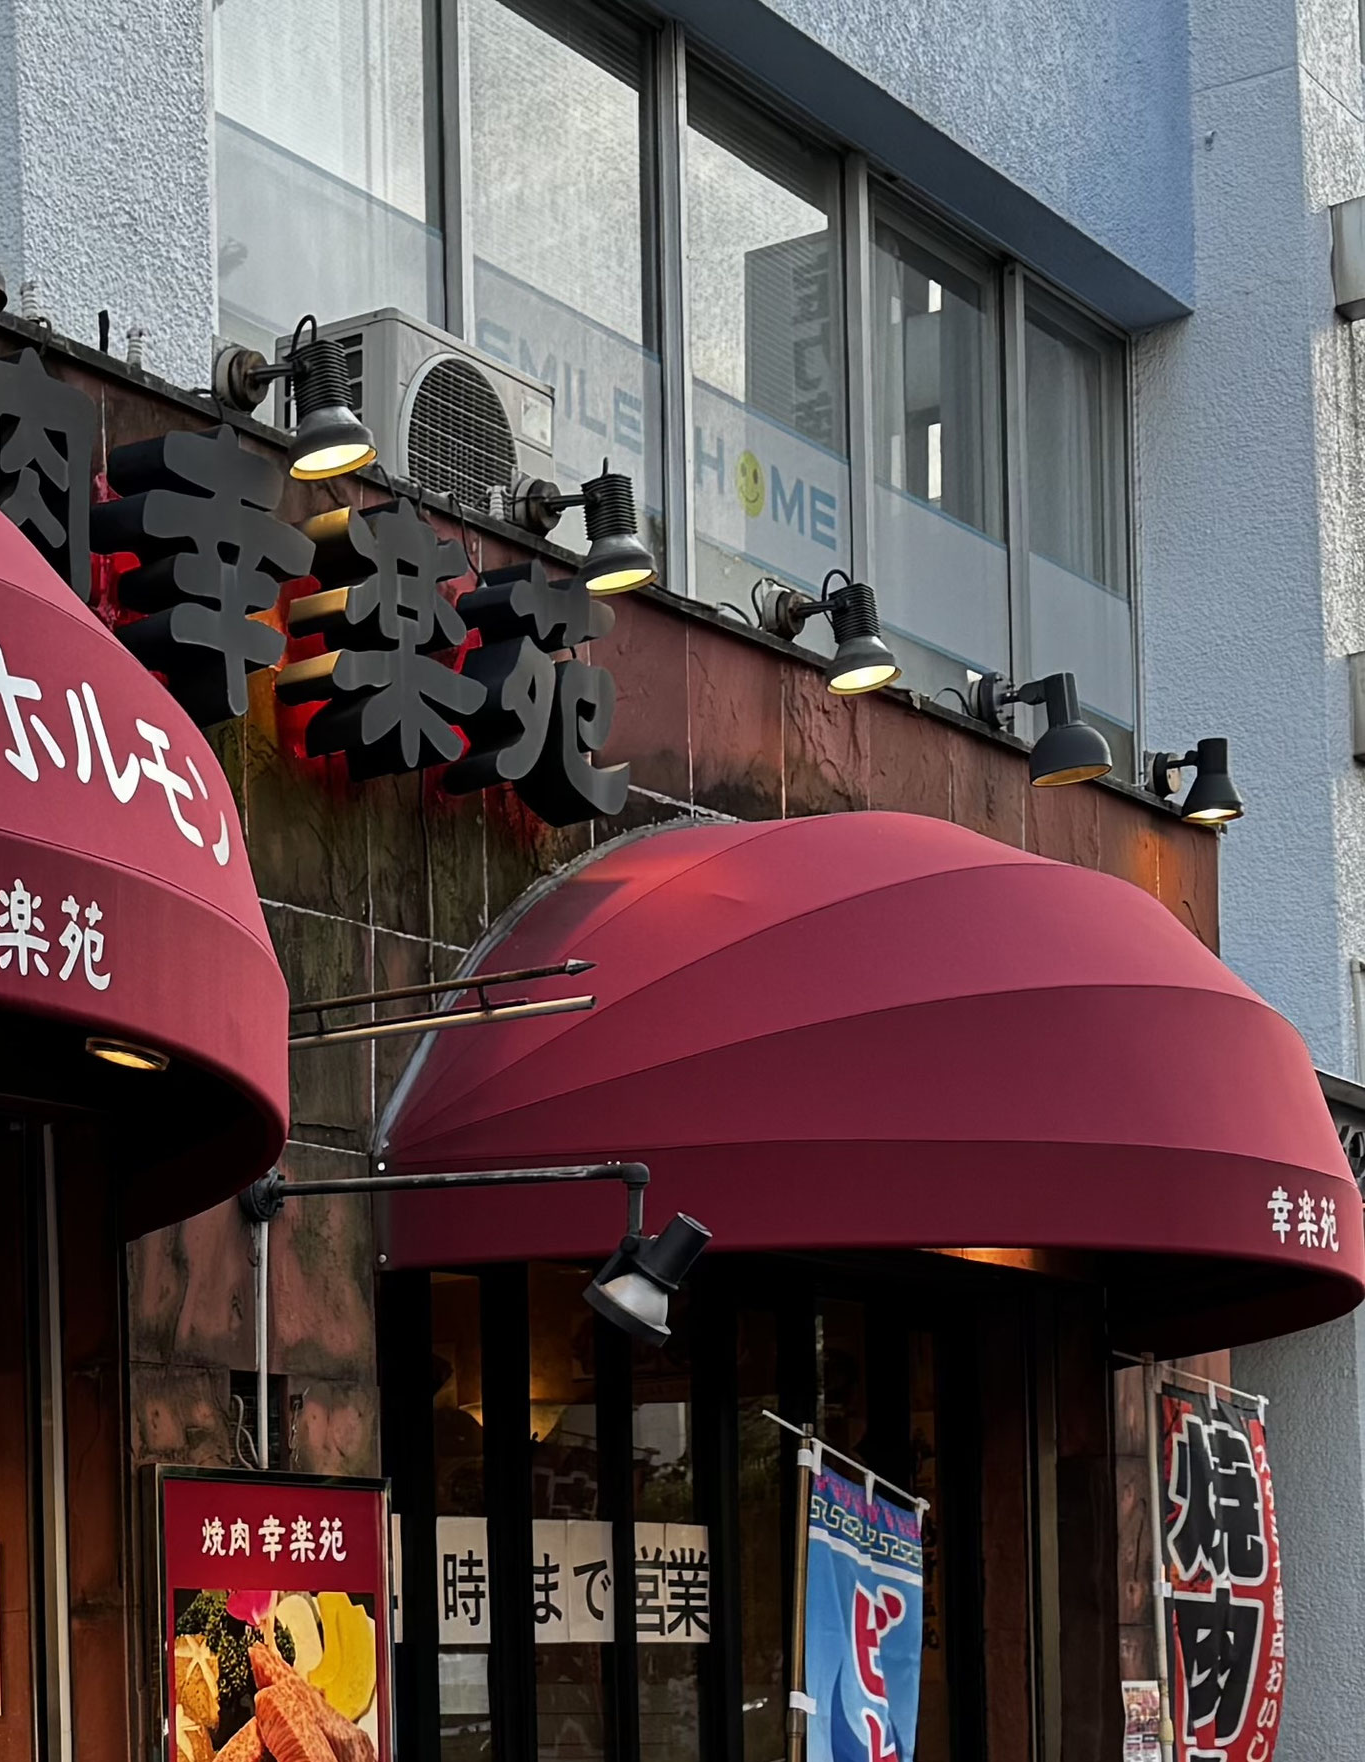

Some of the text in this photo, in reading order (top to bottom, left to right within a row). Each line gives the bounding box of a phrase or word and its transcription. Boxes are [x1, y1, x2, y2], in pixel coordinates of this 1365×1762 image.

[476, 316, 643, 456] SMILE
[1267, 1185, 1340, 1253] 幸楽苑
[201, 1514, 348, 1563] 焼肉幸楽苑
